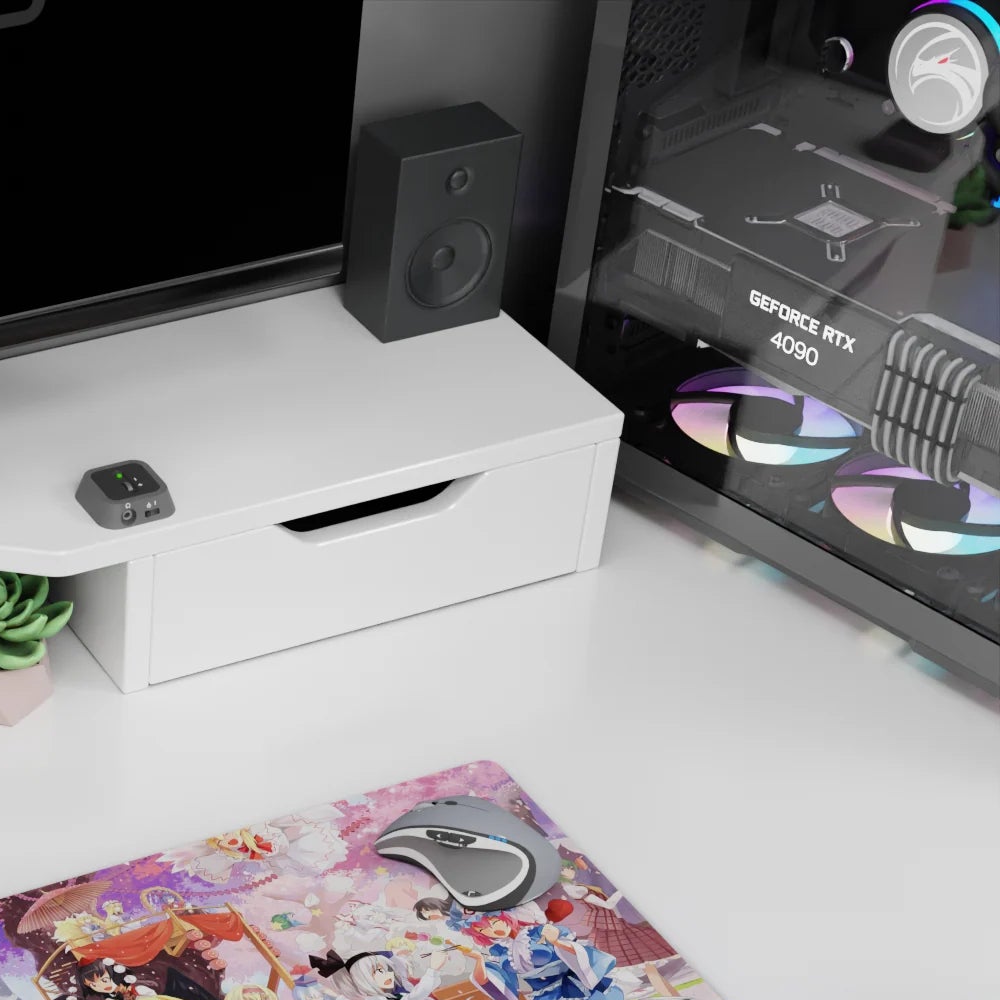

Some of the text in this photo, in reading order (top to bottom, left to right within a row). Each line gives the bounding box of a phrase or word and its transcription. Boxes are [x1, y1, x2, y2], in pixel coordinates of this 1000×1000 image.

[750, 289, 856, 353] GEFORCE RTX
[770, 332, 819, 366] 4090
